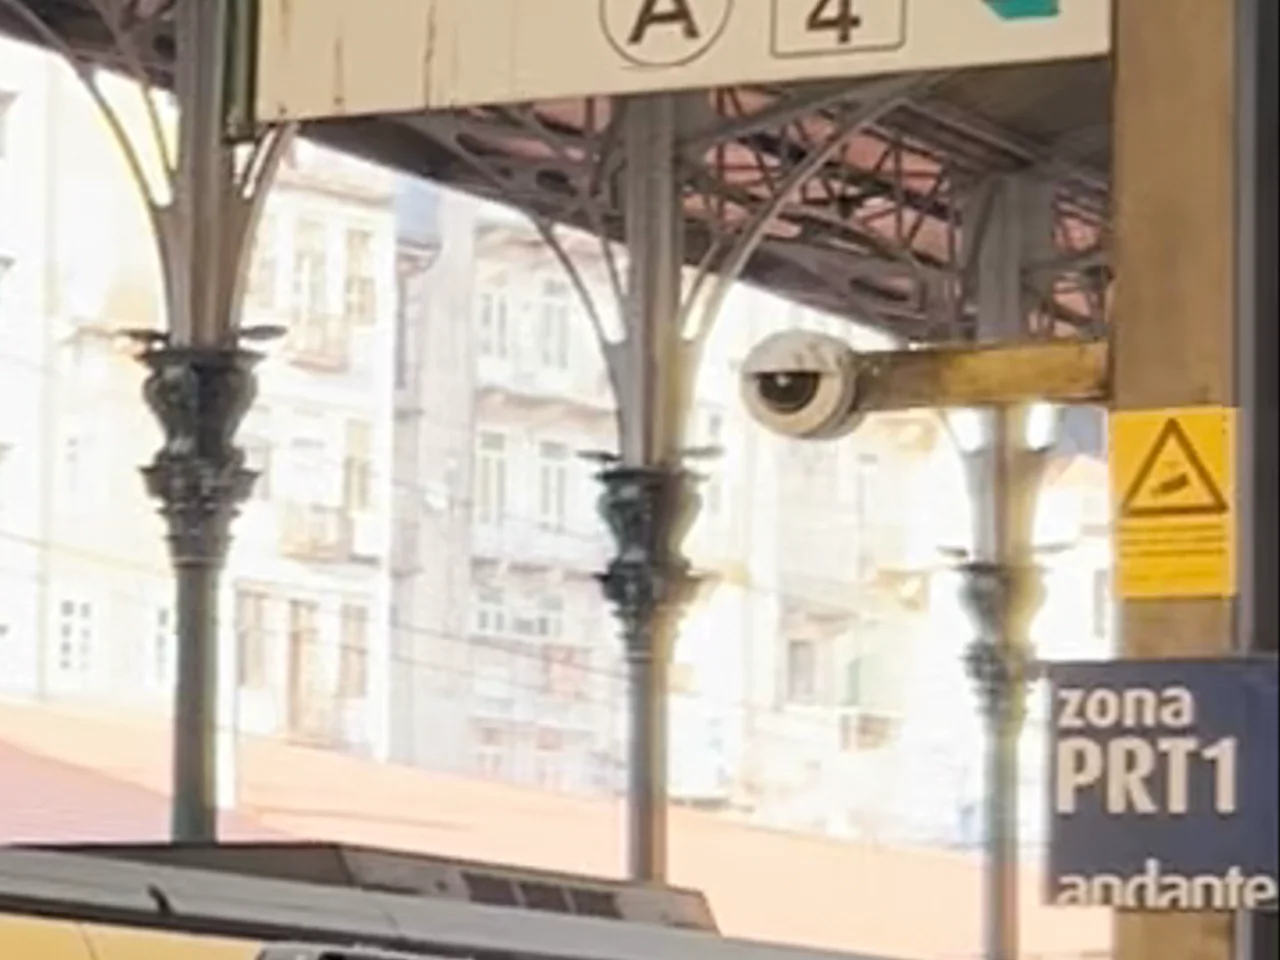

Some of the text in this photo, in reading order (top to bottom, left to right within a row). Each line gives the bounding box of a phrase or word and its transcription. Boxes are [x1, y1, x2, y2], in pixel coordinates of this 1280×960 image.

[1057, 687, 1194, 730] zona
[1054, 737, 1237, 814] PRT1
[1055, 858, 1278, 909] andante
